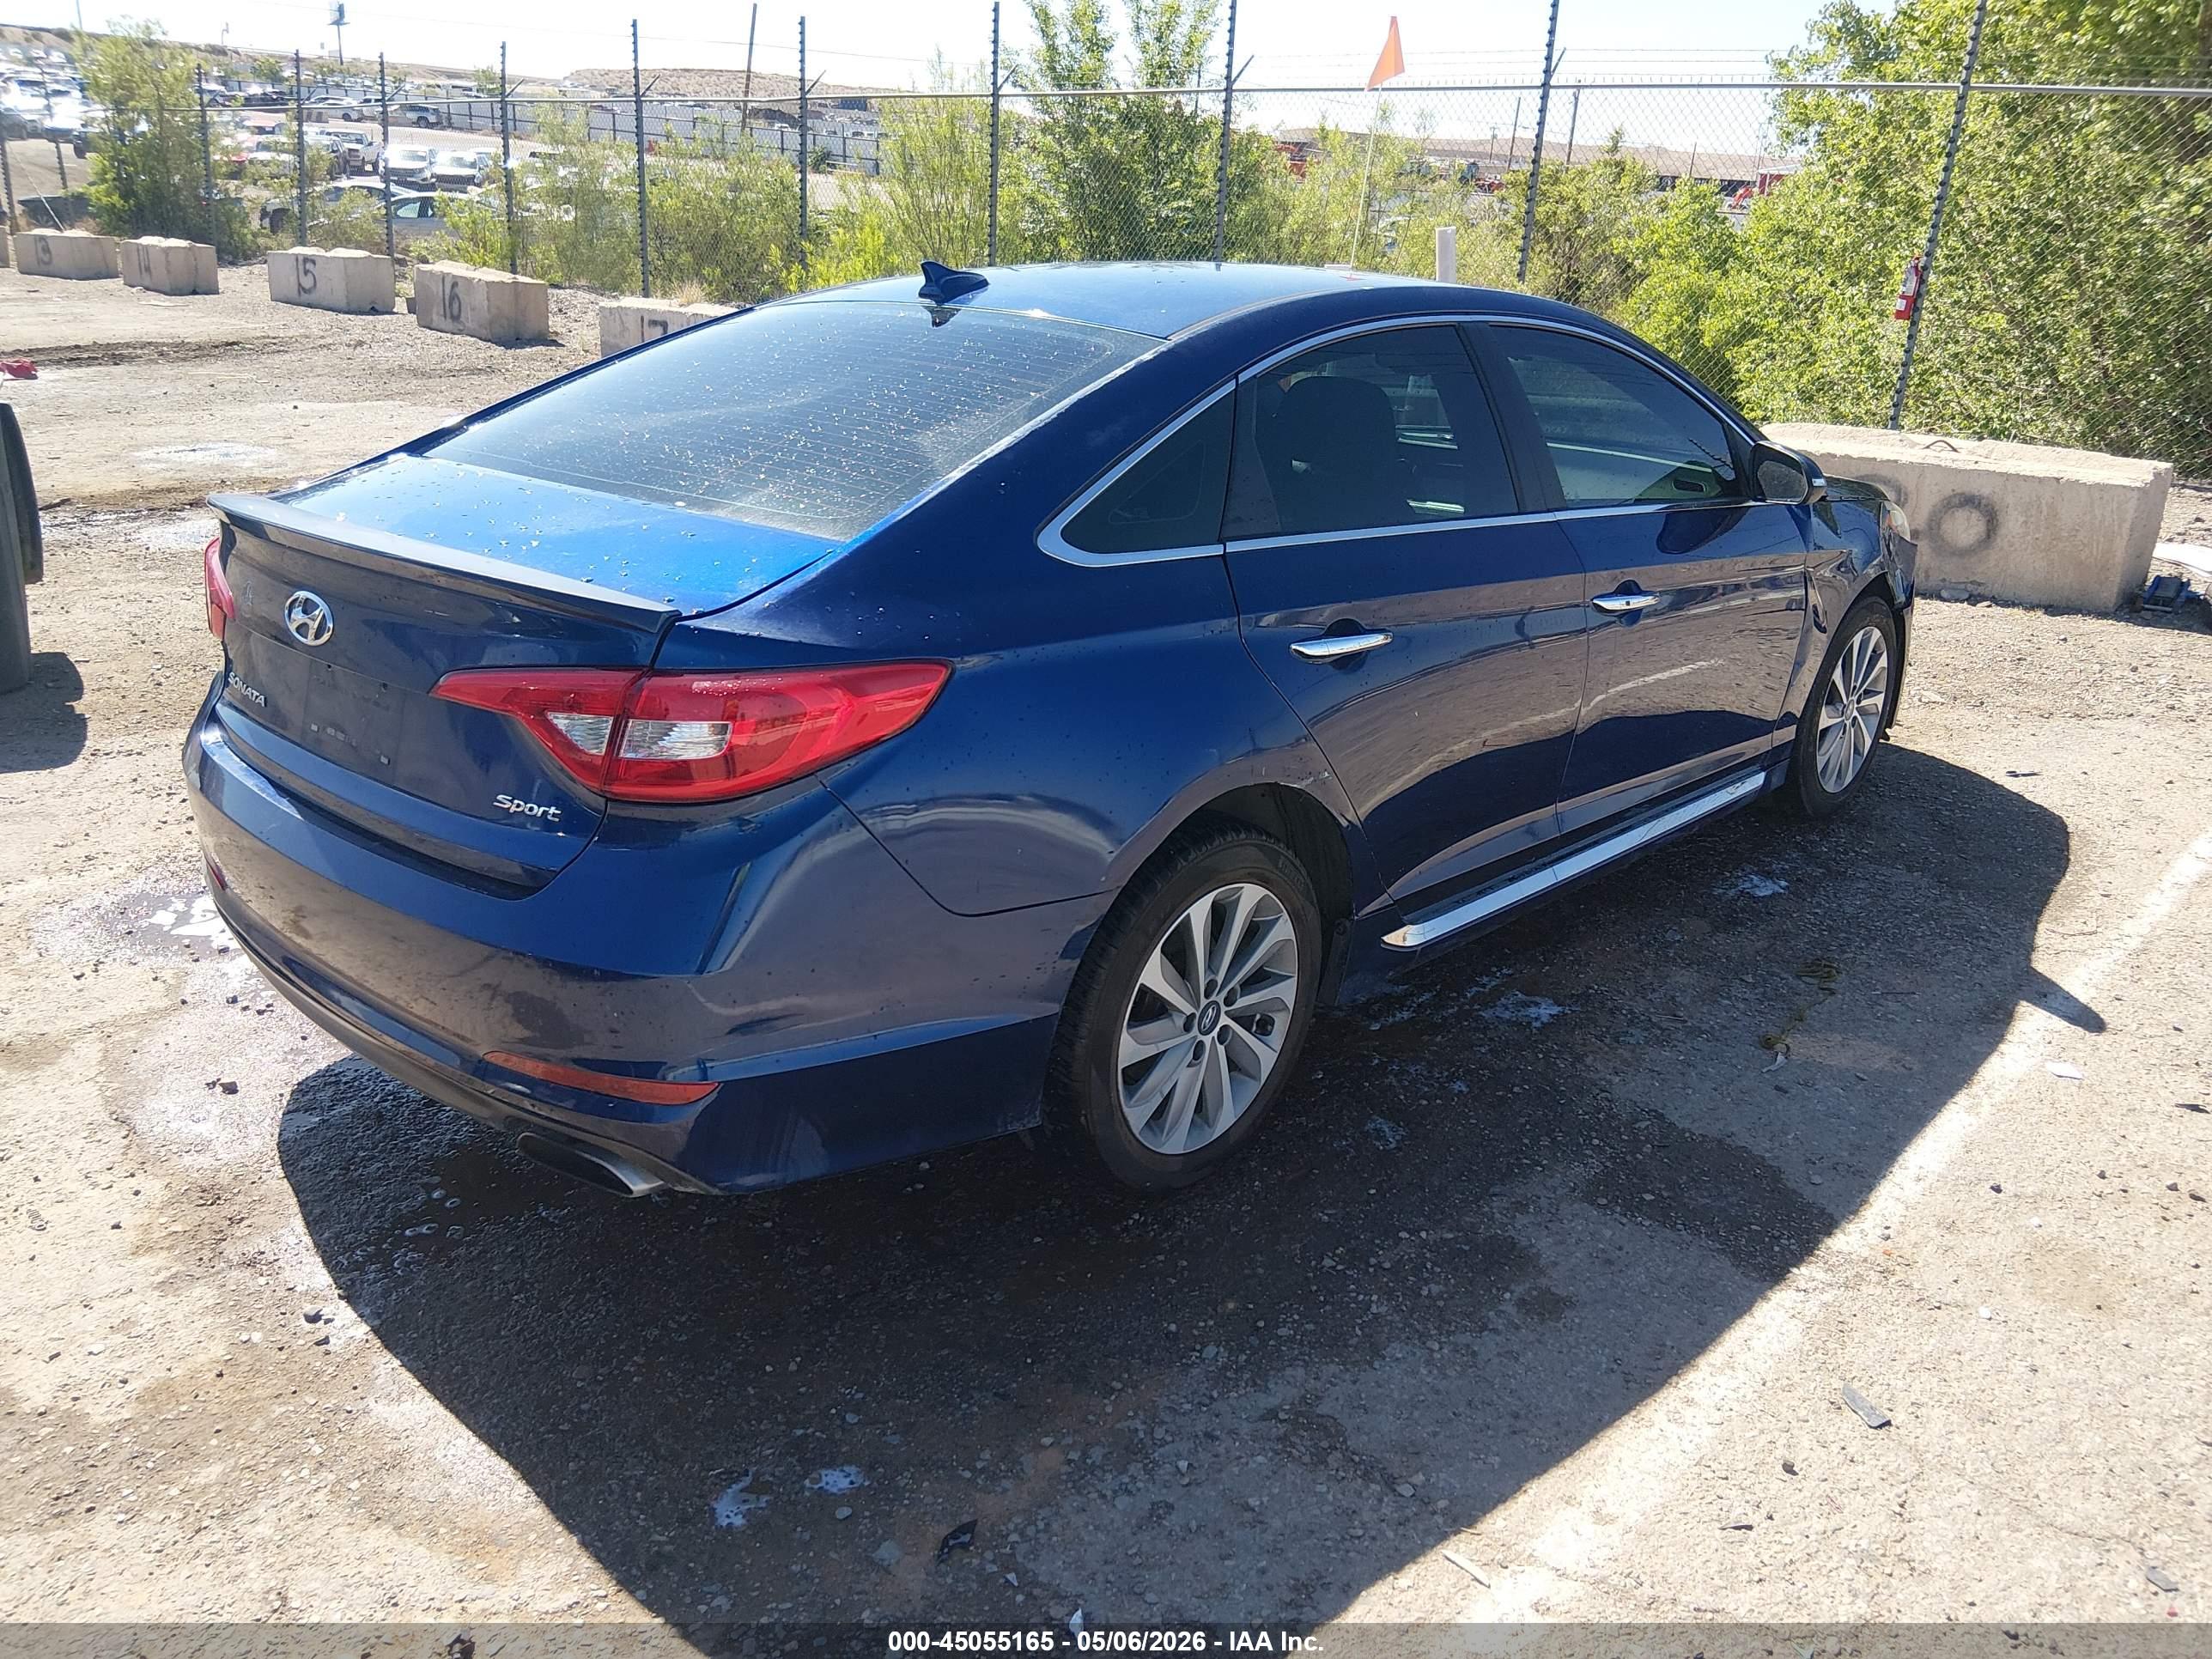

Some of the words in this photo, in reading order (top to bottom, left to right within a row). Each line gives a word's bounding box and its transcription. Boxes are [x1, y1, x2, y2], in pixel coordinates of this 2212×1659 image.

[295, 255, 317, 296] 15
[441, 275, 462, 322] 16
[228, 672, 265, 708] SONATA
[492, 794, 562, 823] Sport
